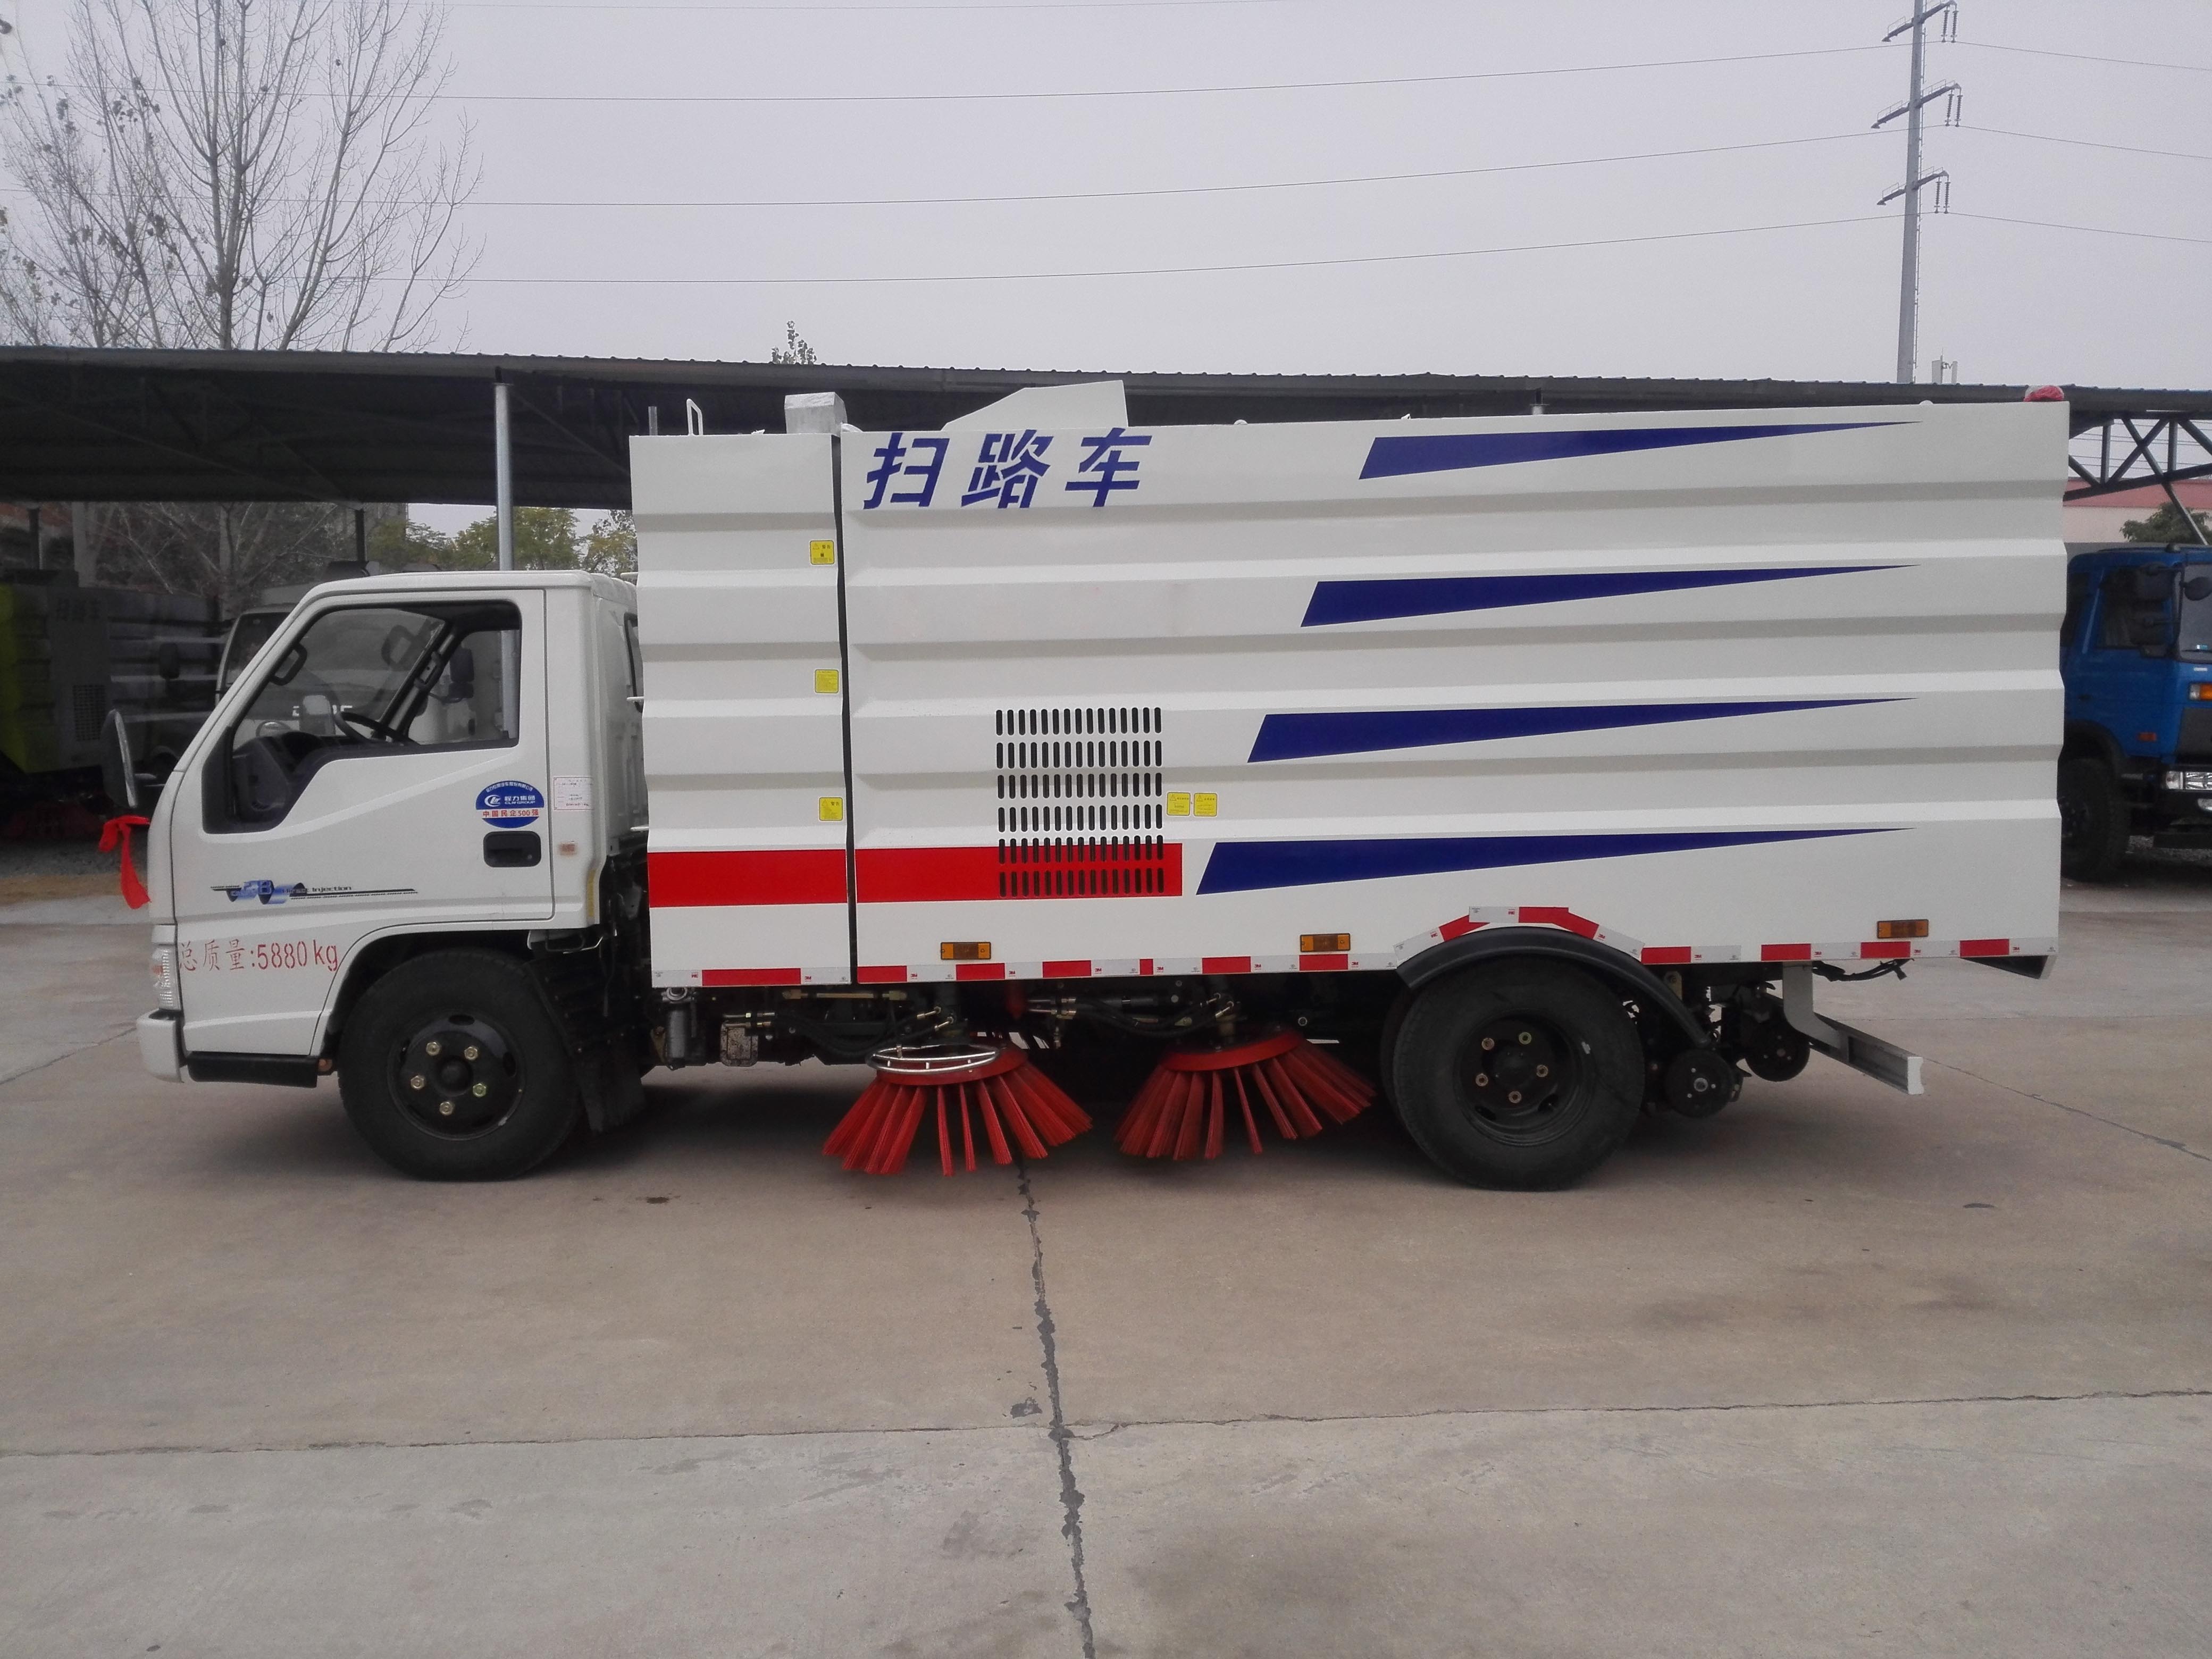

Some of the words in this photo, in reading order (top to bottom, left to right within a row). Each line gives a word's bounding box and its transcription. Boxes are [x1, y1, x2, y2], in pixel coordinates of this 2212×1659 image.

[864, 428, 1152, 509] 扫路车
[483, 809, 539, 817] 中国民企500强
